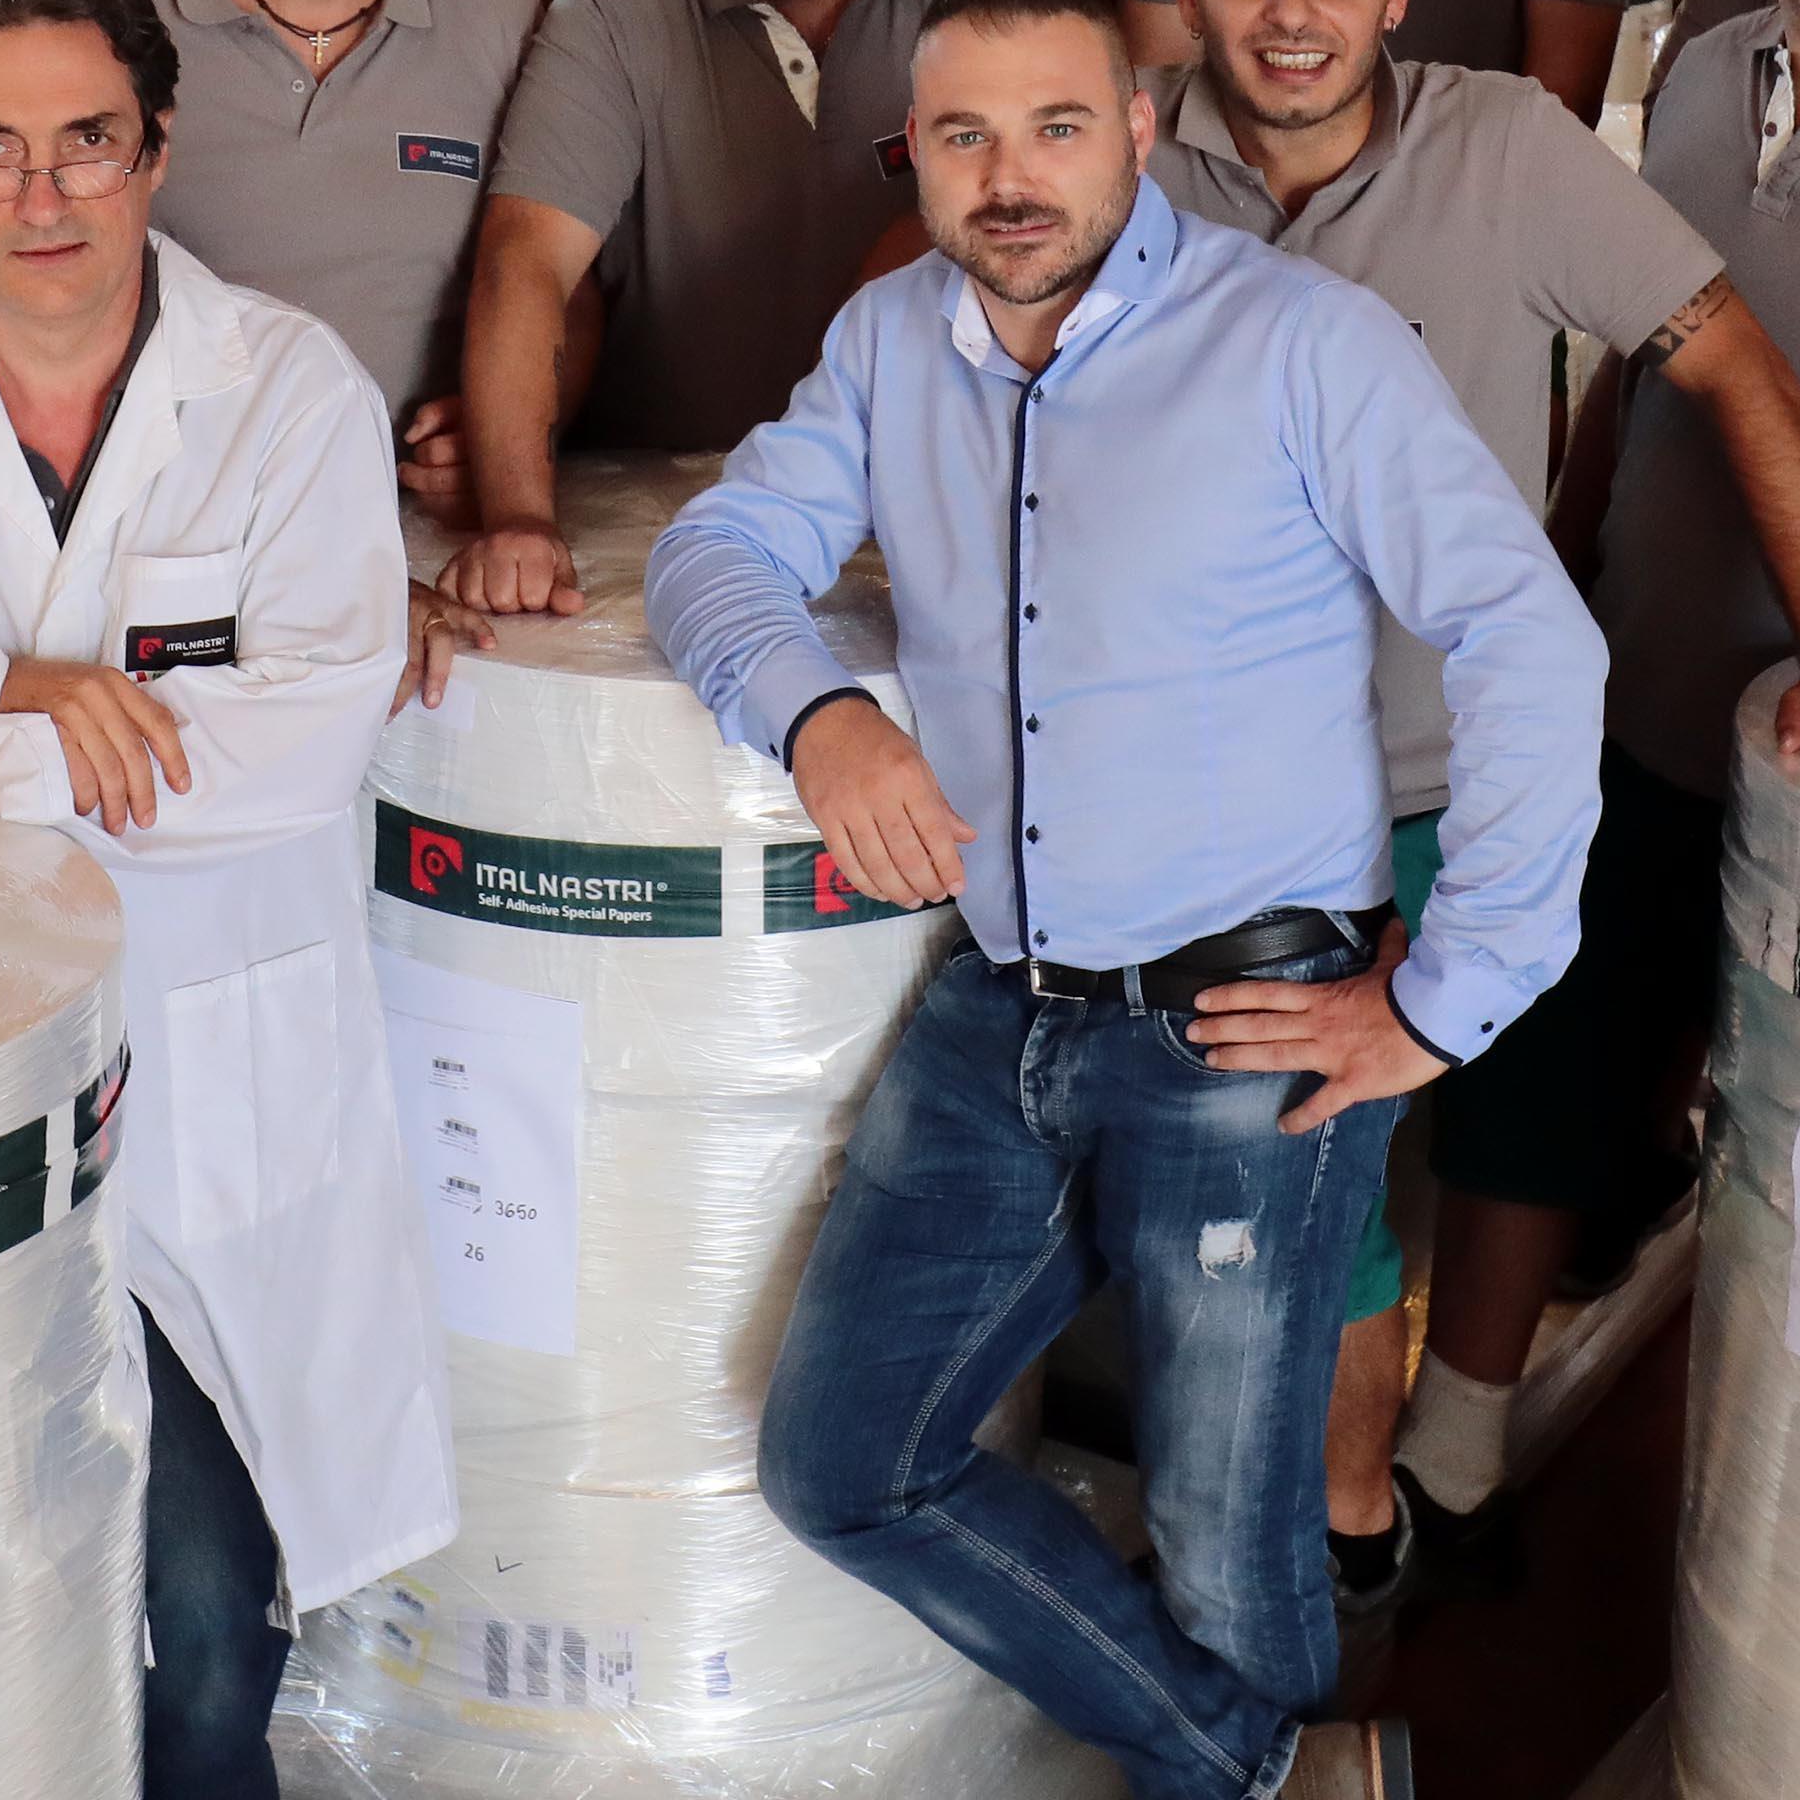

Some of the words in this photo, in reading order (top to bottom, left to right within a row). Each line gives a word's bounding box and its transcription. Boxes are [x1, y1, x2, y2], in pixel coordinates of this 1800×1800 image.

[166, 636, 226, 652] ITALNASTRI
[506, 897, 559, 917] Adhesive
[561, 903, 607, 923] Special
[609, 908, 653, 924] Papers
[494, 1199, 538, 1221] 3650
[464, 1242, 485, 1262] 26
